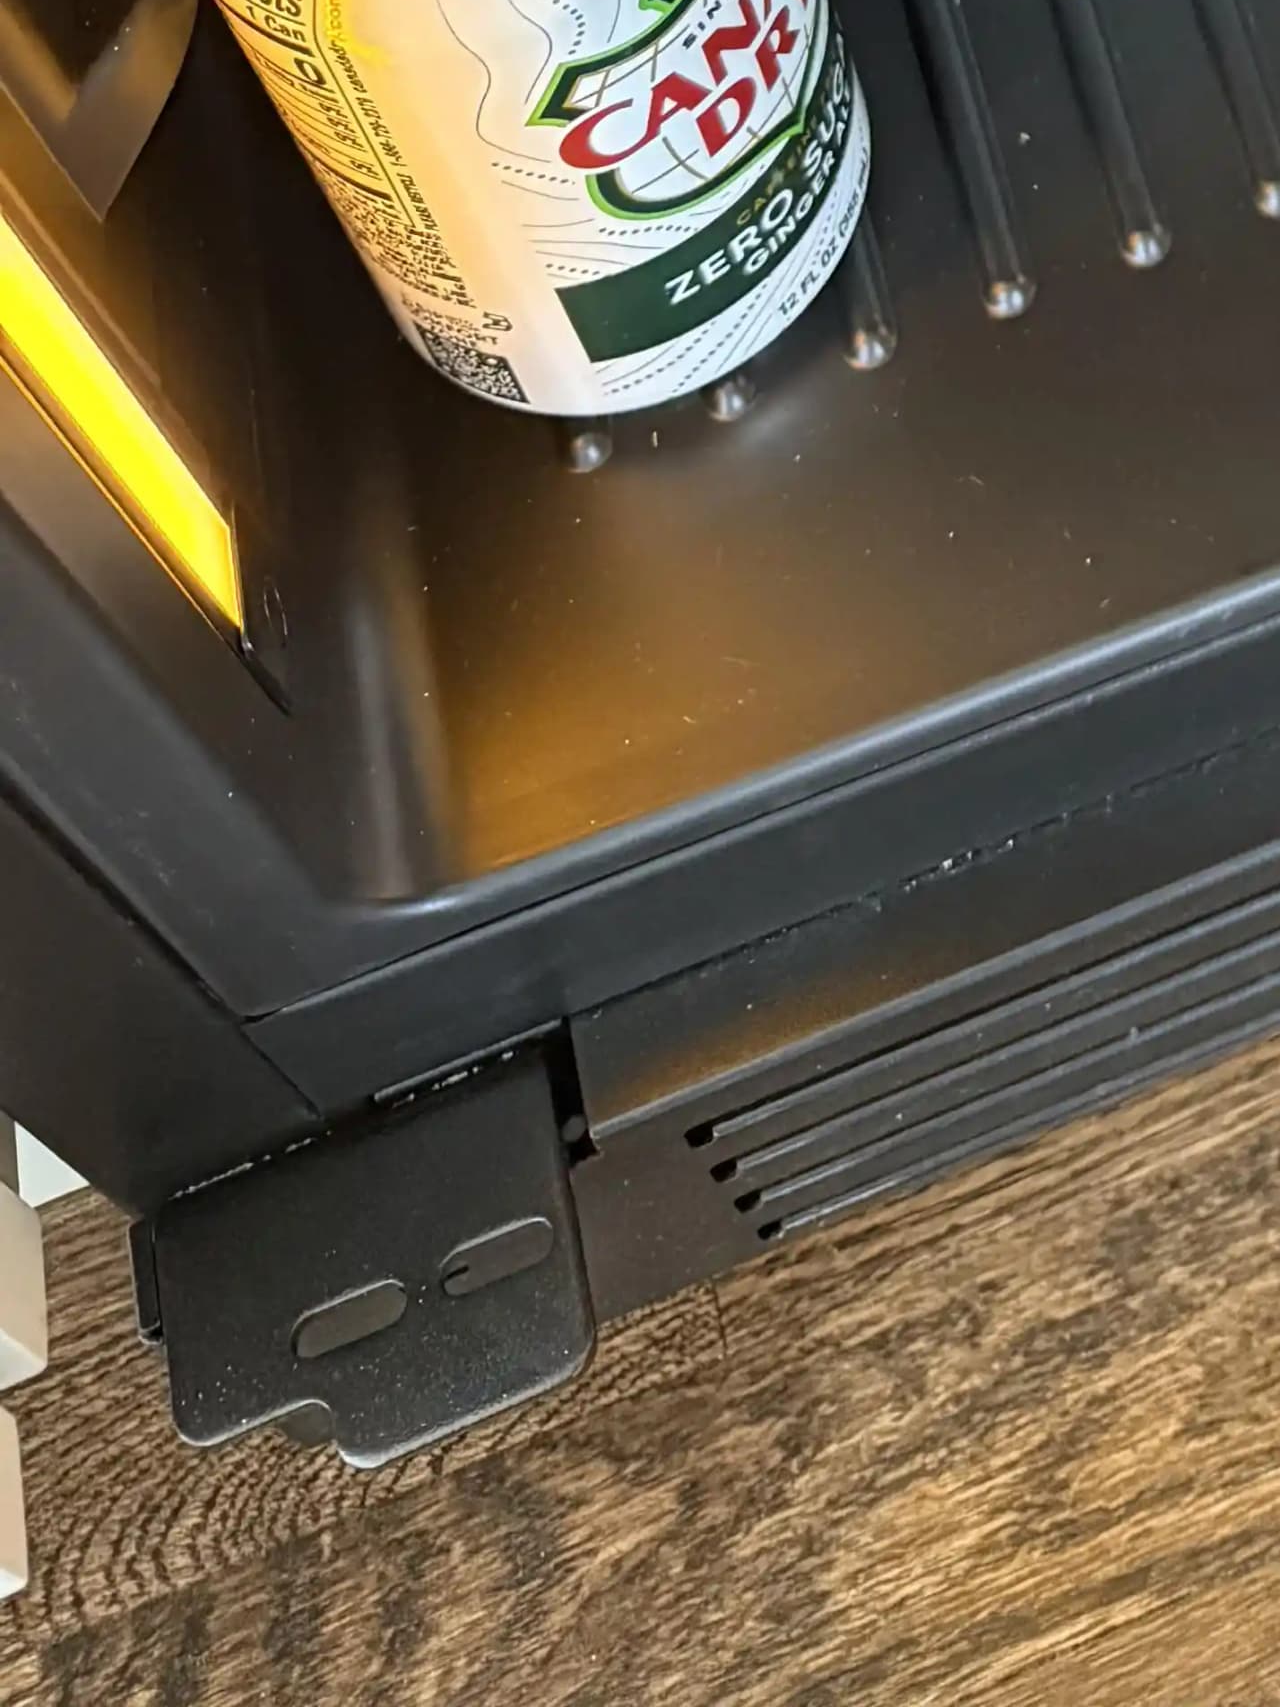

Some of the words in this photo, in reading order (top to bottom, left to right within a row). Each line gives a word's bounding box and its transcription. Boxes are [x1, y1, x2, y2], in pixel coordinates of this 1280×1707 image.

[264, 14, 307, 44] Can
[293, 56, 327, 89] 0
[664, 188, 794, 307] ZERO
[742, 150, 836, 276] GINGER
[778, 292, 802, 316] 12
[800, 269, 822, 294] FL
[820, 240, 841, 268] OZ
